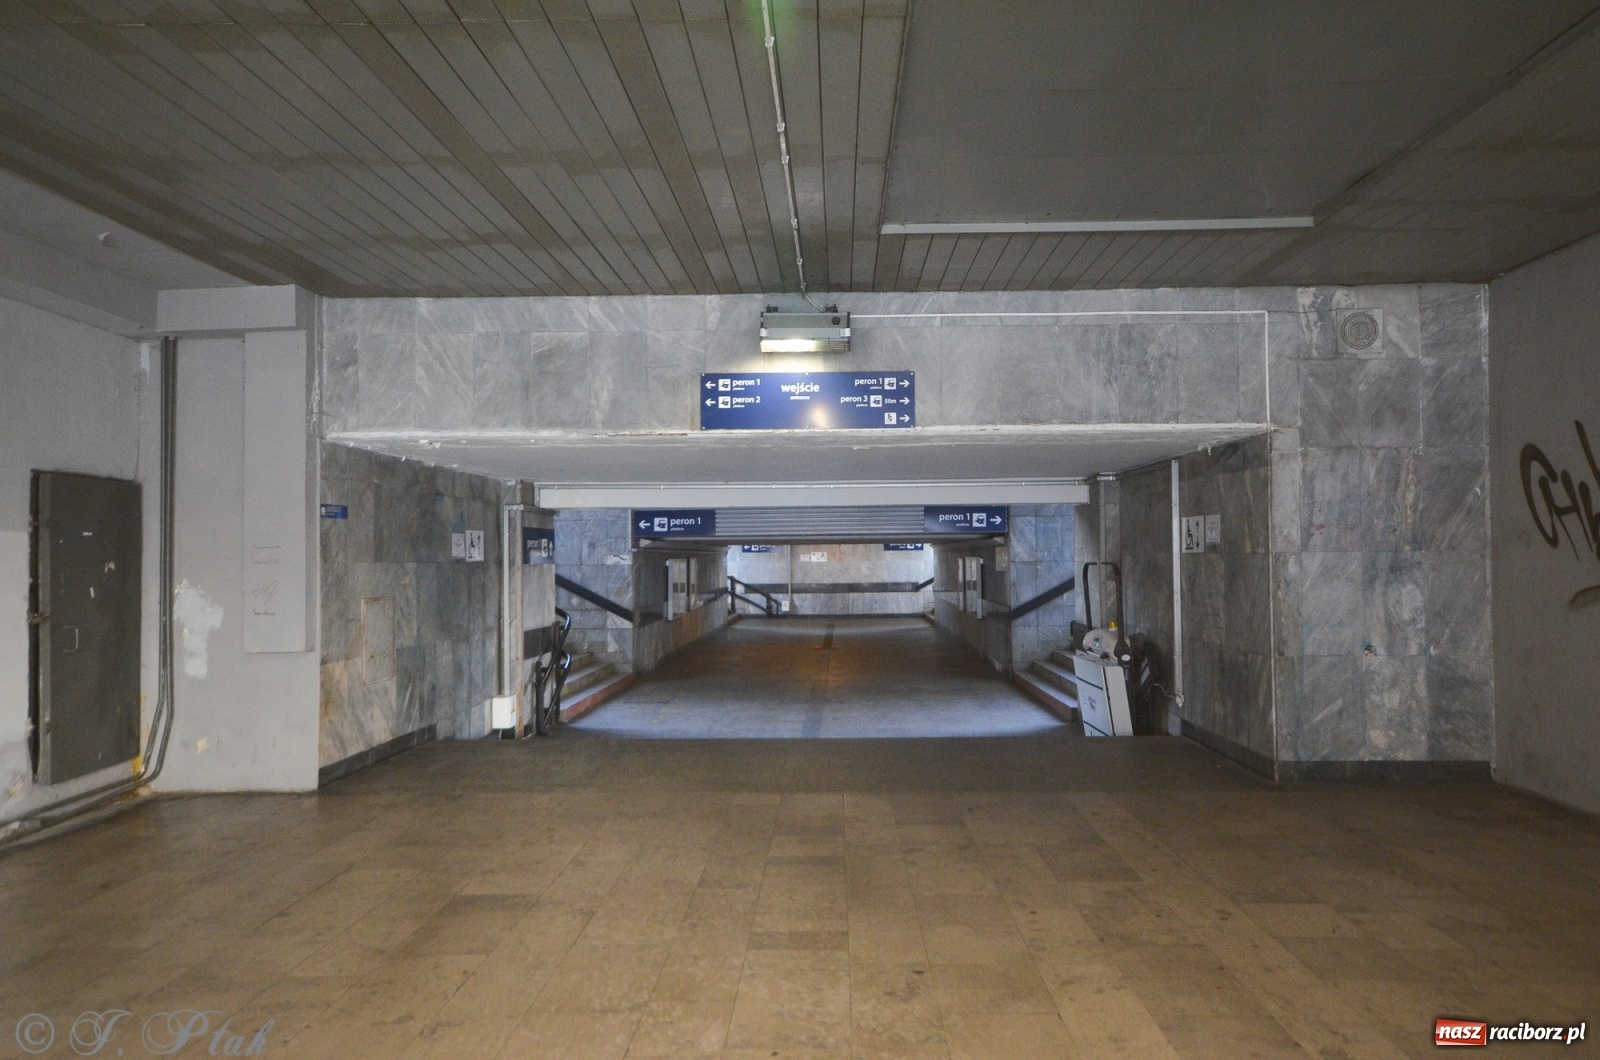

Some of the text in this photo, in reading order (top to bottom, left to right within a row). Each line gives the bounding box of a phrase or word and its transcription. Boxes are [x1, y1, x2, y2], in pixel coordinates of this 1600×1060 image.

[732, 378, 761, 387] peron 1
[854, 377, 883, 387] peron 1
[780, 382, 820, 394] wejście
[732, 395, 761, 405] peron 2
[840, 394, 868, 404] peron 3
[670, 517, 701, 527] peron 1
[939, 513, 970, 522] peron 1
